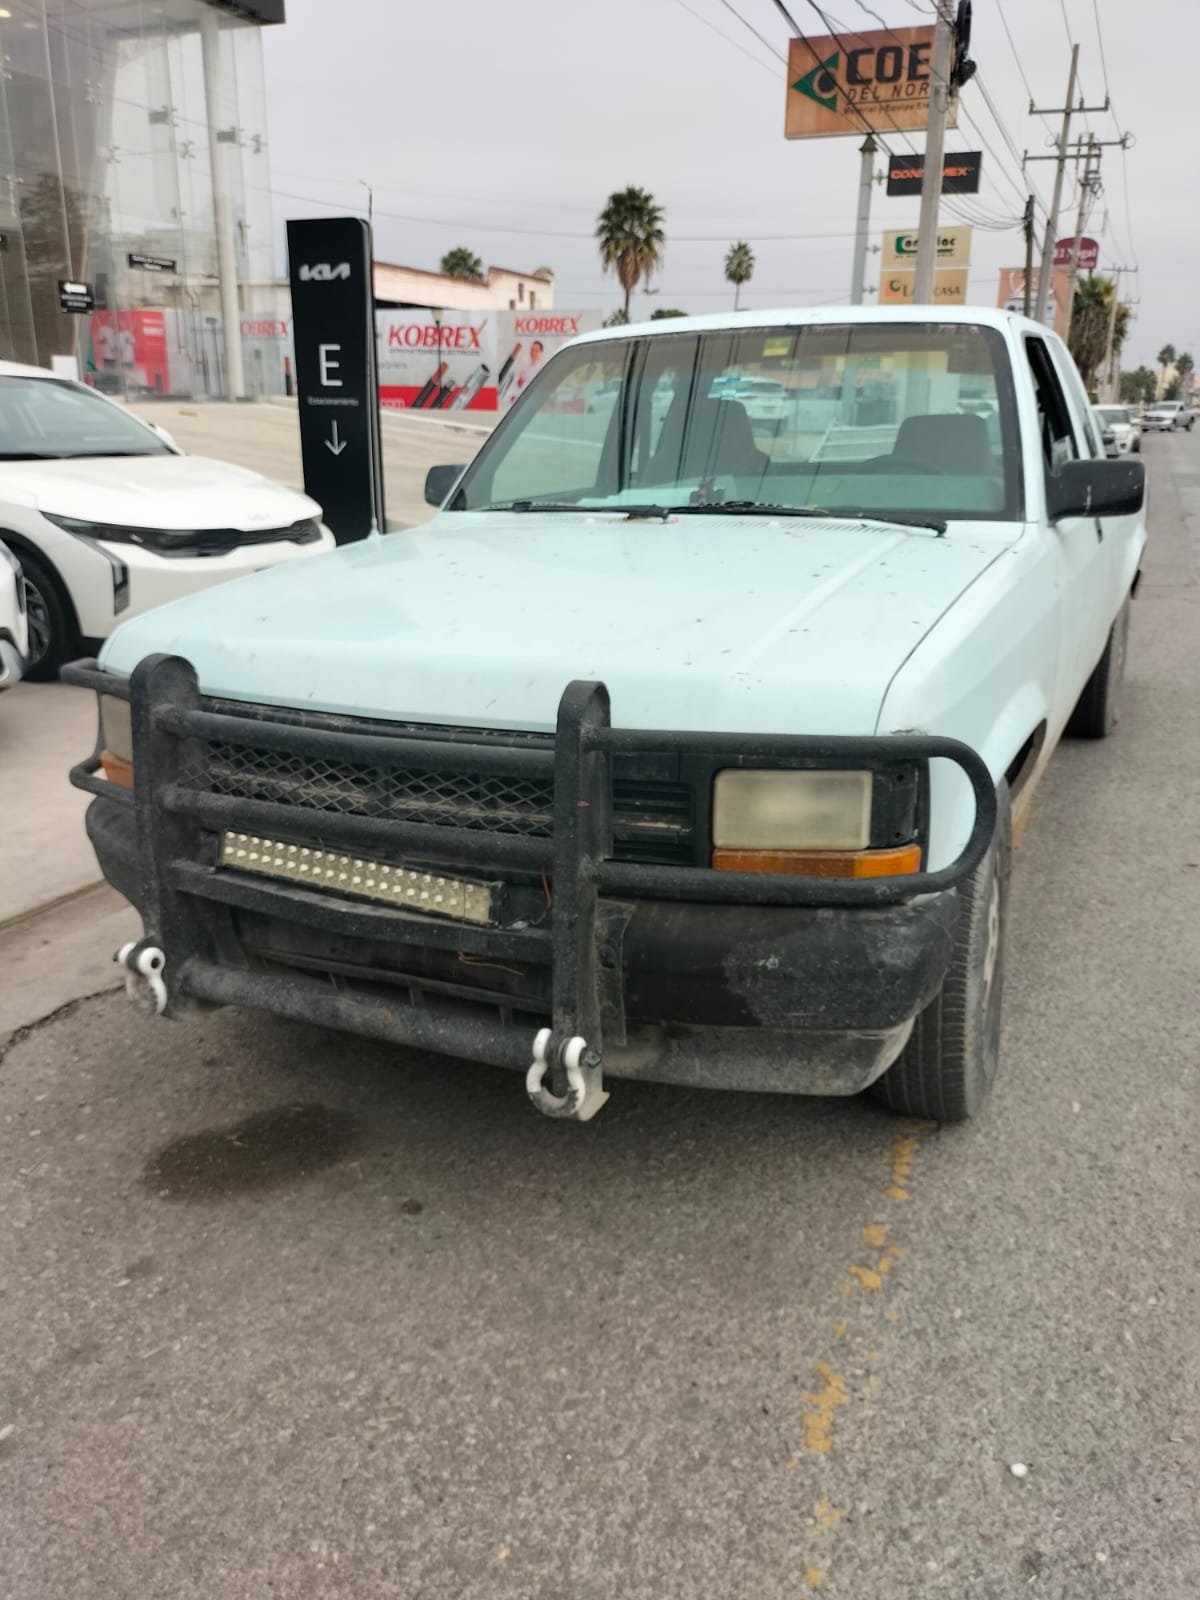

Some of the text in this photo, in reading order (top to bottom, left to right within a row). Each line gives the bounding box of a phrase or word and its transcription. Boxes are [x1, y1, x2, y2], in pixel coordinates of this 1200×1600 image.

[848, 83, 930, 102] DEL NOR
[240, 320, 287, 336] OBREX
[515, 313, 580, 332] KOBREX
[388, 319, 486, 348] KOBREX
[319, 344, 342, 386] E
